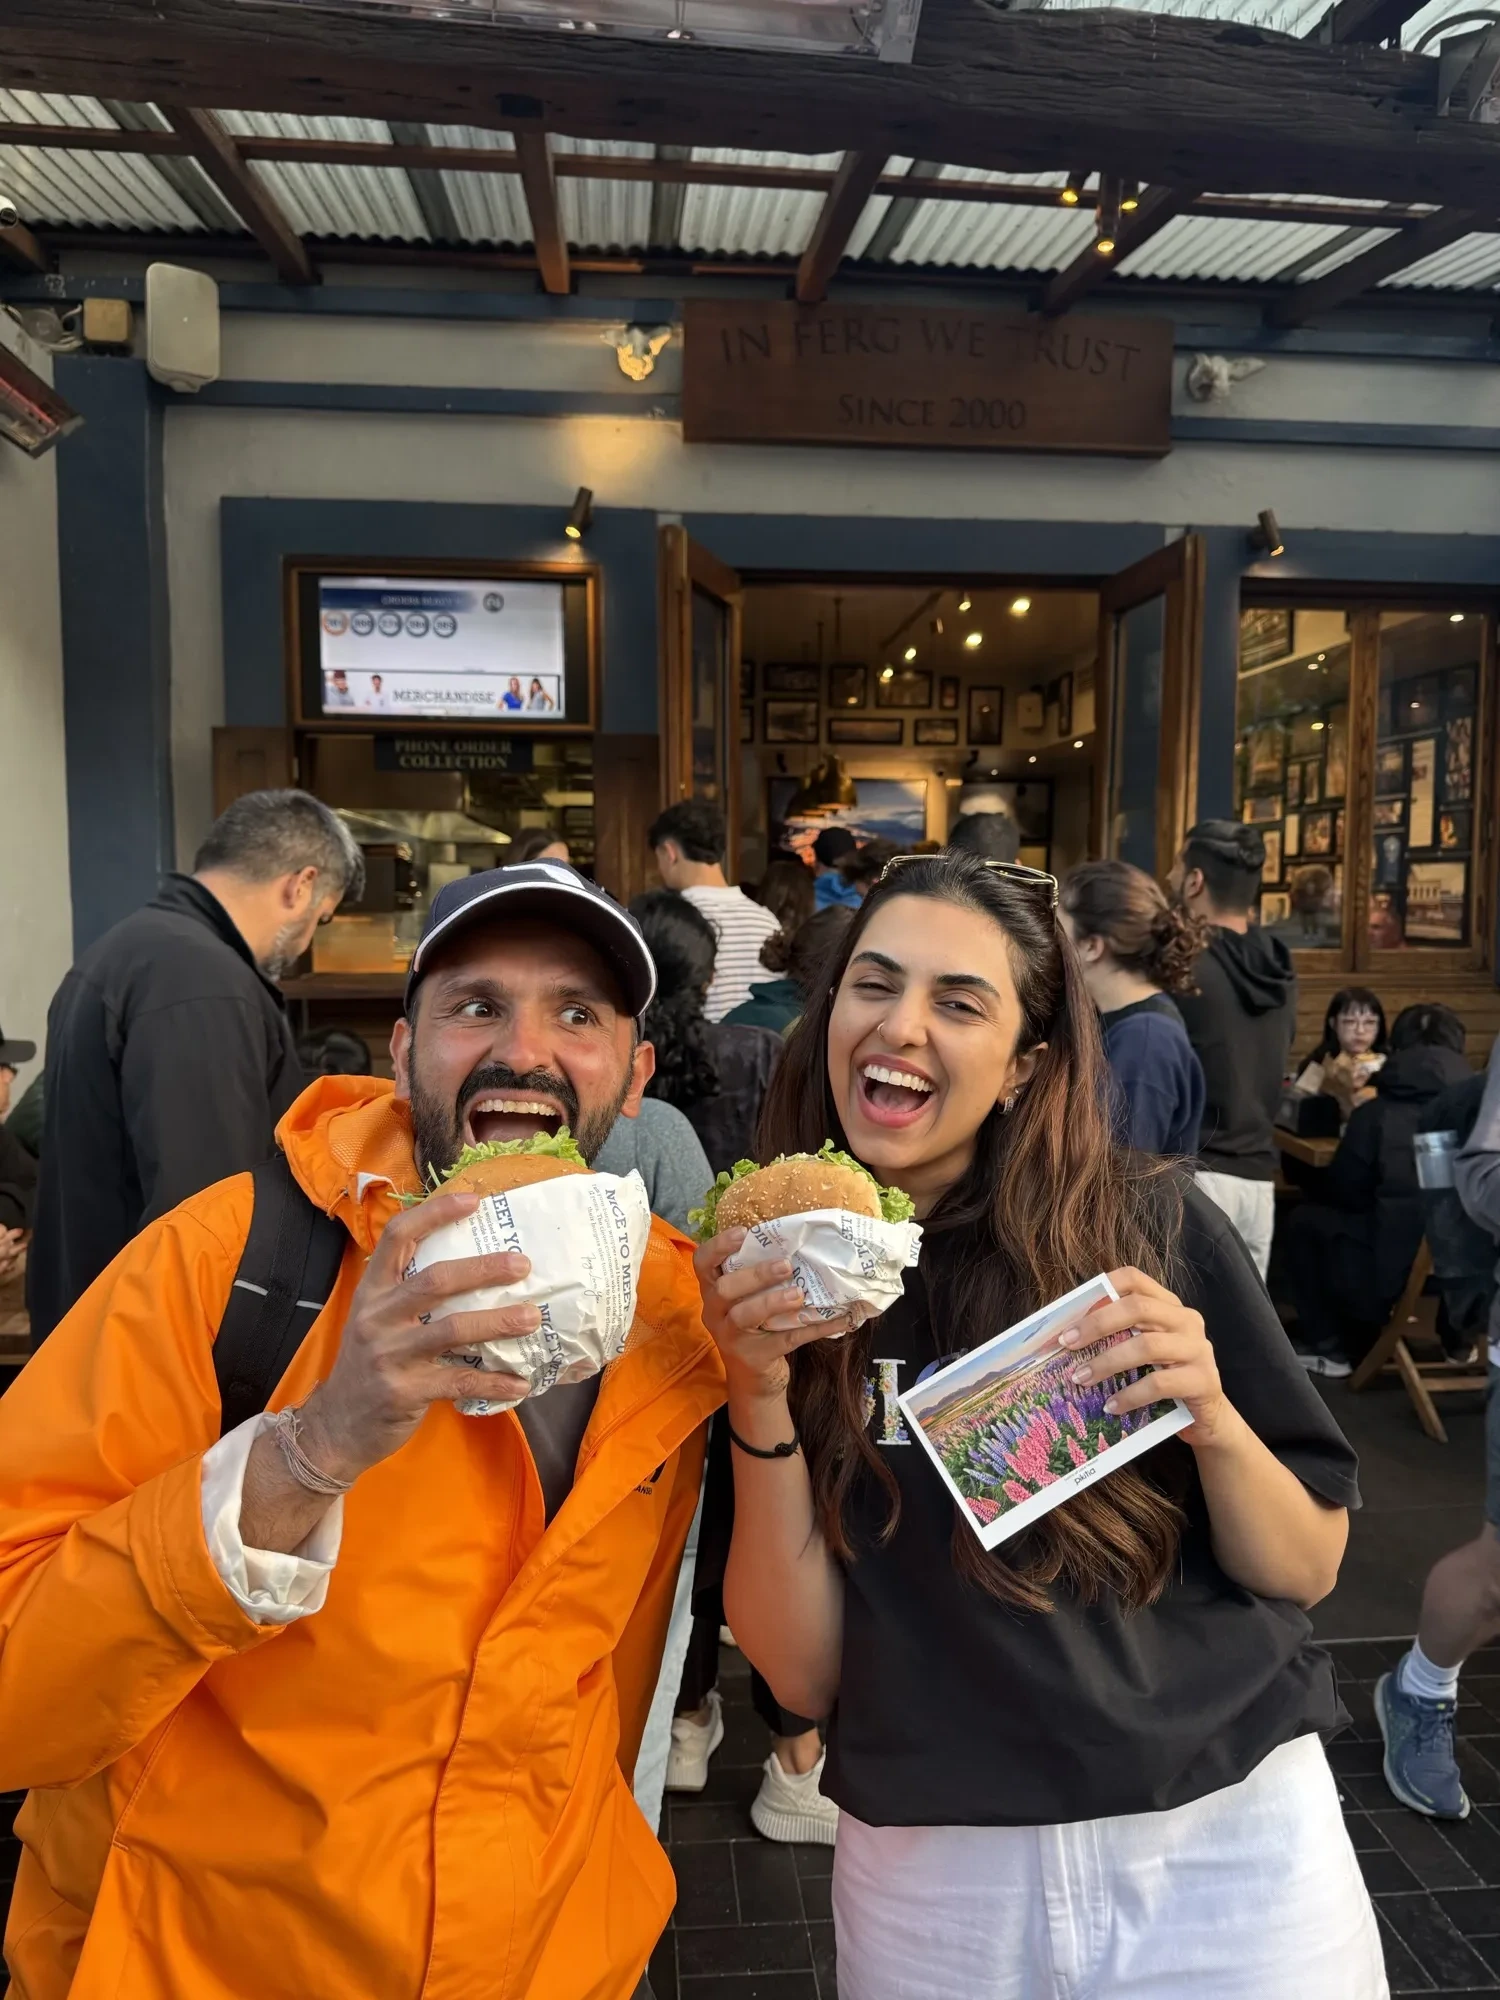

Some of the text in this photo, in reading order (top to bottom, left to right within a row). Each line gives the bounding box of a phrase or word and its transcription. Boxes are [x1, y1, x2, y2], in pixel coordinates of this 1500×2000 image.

[721, 317, 1142, 381] IN FERG WE TRUST
[837, 394, 1028, 431] SINCE 2000
[392, 689, 496, 705] MERCHANDISE
[394, 739, 512, 754] PHONE ORDER
[399, 755, 508, 769] COLLECTION
[606, 1190, 626, 1228] NICE
[469, 1217, 475, 1226] be
[477, 1214, 486, 1235] decide
[485, 1212, 496, 1234] worked
[618, 1233, 628, 1258] TO
[750, 1225, 772, 1248] NIC
[910, 1238, 919, 1261] NIC
[622, 1263, 632, 1311] MEET
[606, 1297, 610, 1305] be
[538, 1303, 559, 1343] NICE
